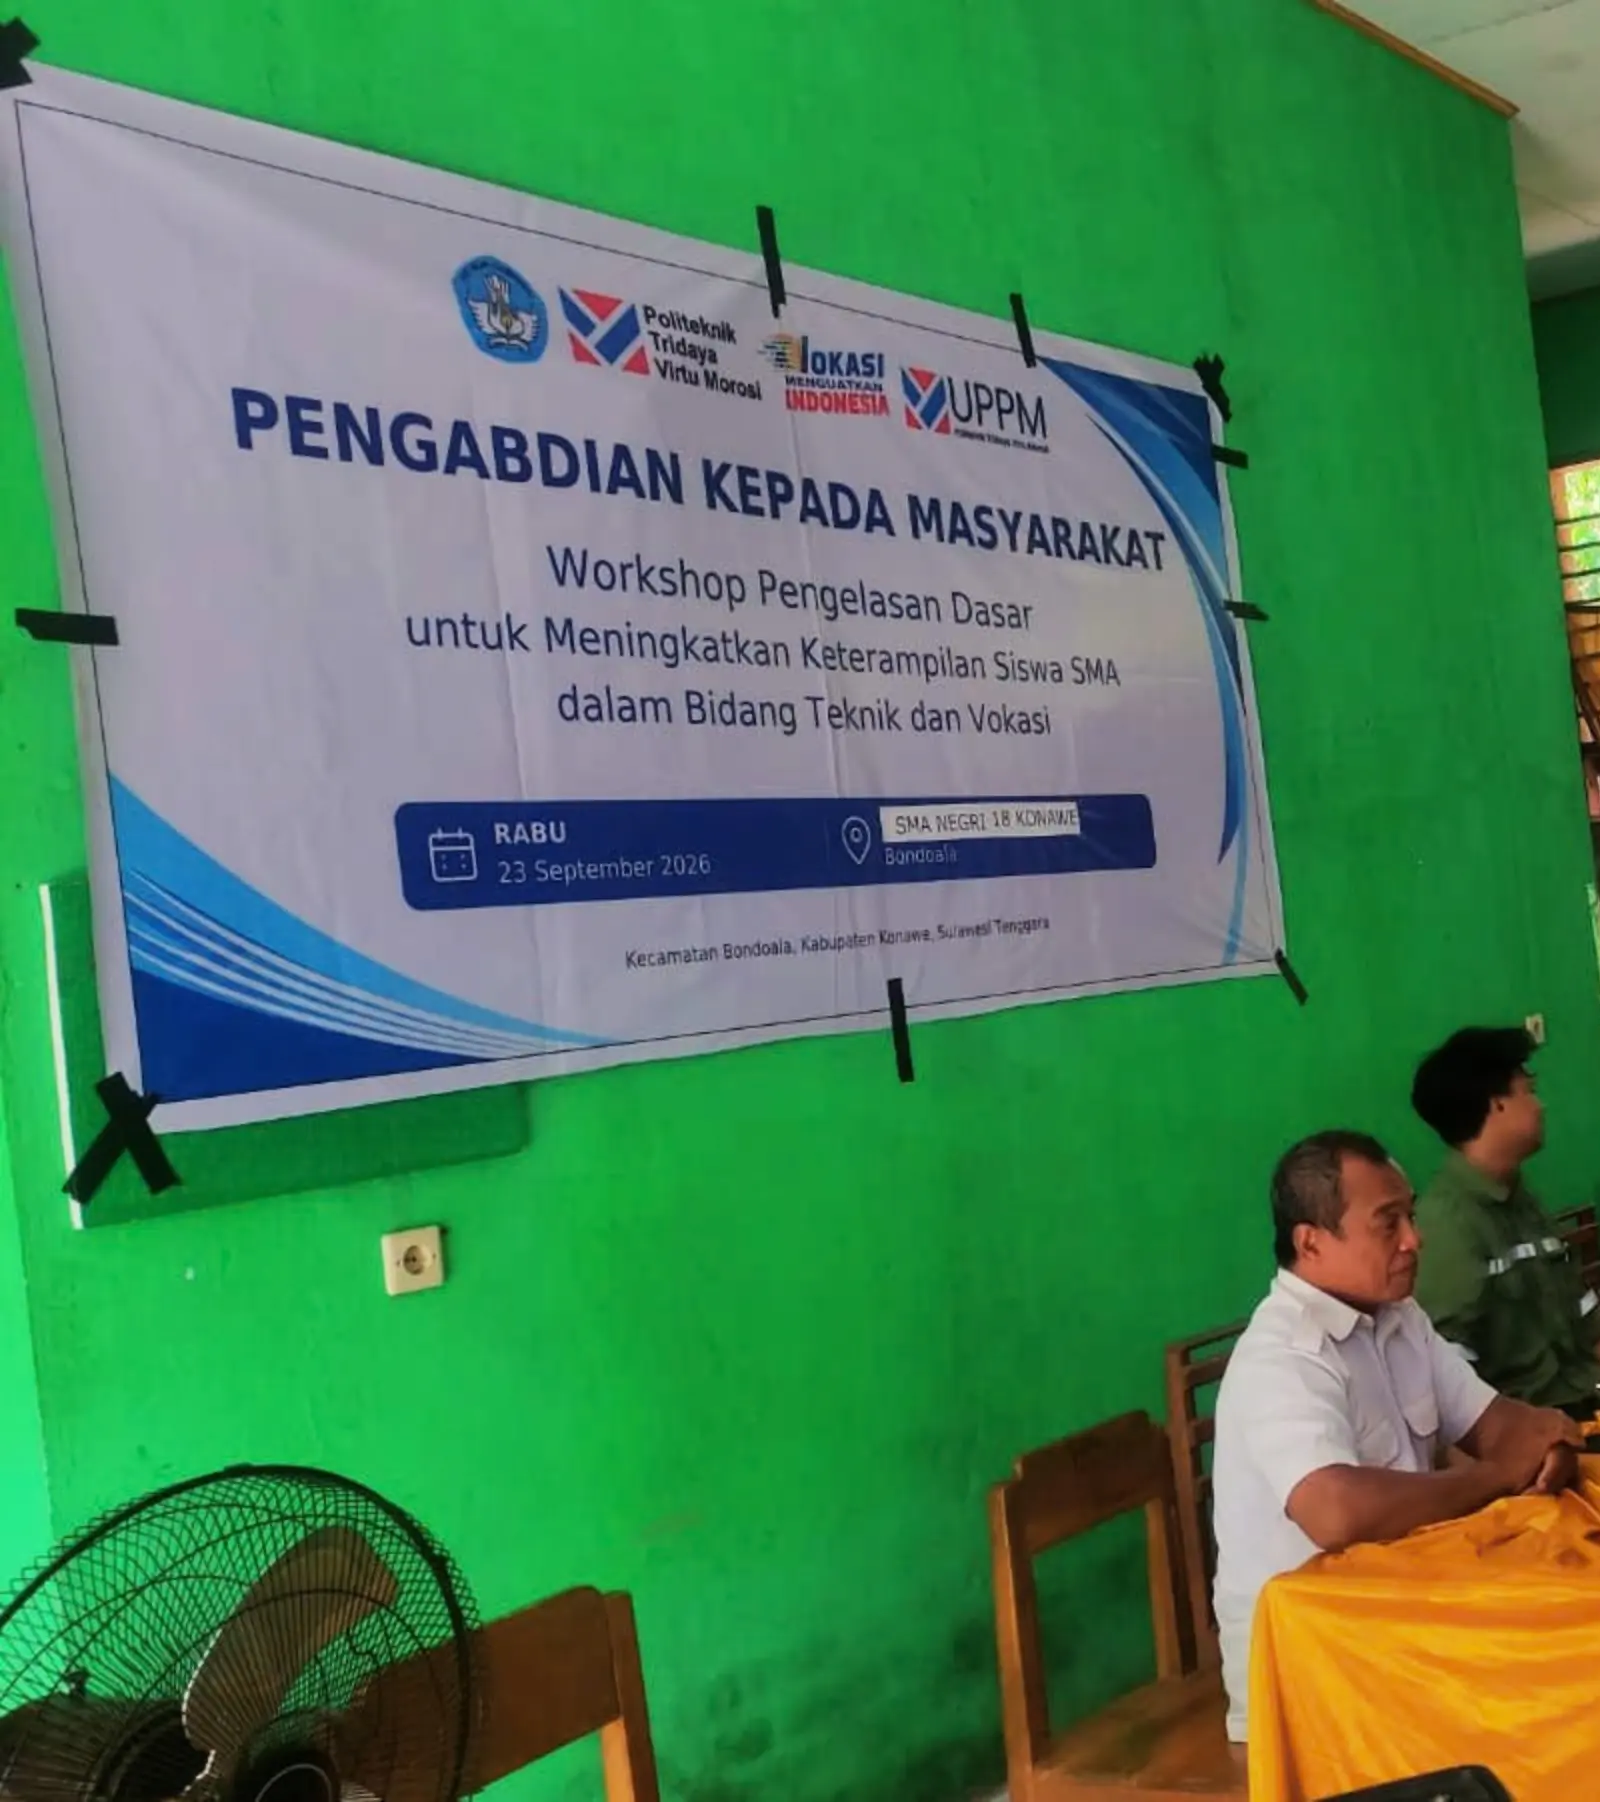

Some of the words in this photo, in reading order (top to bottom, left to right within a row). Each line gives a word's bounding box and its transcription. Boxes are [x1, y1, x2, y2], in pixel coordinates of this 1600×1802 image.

[643, 305, 737, 344] Politeknik
[648, 331, 718, 365] Tridaya
[654, 358, 700, 387] Virtu
[703, 372, 763, 400] Morosi
[786, 389, 889, 416] INDONESIA
[947, 376, 1047, 439] UPPM
[231, 387, 684, 505] PENGABDIAN
[702, 458, 896, 538] KEPADA
[908, 493, 1166, 571] MASYARAKAT
[546, 545, 745, 612] Workshop
[758, 569, 942, 622] Pengelasan
[951, 591, 1034, 630] Dasar
[406, 612, 530, 652] untuk
[545, 616, 790, 668] Meningkatkan
[800, 636, 987, 684] Keterampilan
[994, 651, 1064, 684] Siswa
[1071, 656, 1121, 687] SMA
[557, 684, 672, 724] dalam
[686, 690, 797, 736] Bidang
[803, 696, 902, 733] Teknik
[911, 700, 961, 732] dan
[968, 702, 1052, 736] Vokasi
[494, 822, 567, 844] RABU
[895, 815, 932, 835] SMA
[936, 813, 986, 833] NEGRI
[1015, 808, 1077, 827] KONAWE
[498, 861, 527, 884] 23
[534, 857, 653, 887] September
[660, 853, 712, 876] 2026
[625, 945, 719, 969] Kecamatan
[723, 939, 796, 960] Bondoala,
[801, 933, 875, 953] Kabupaten
